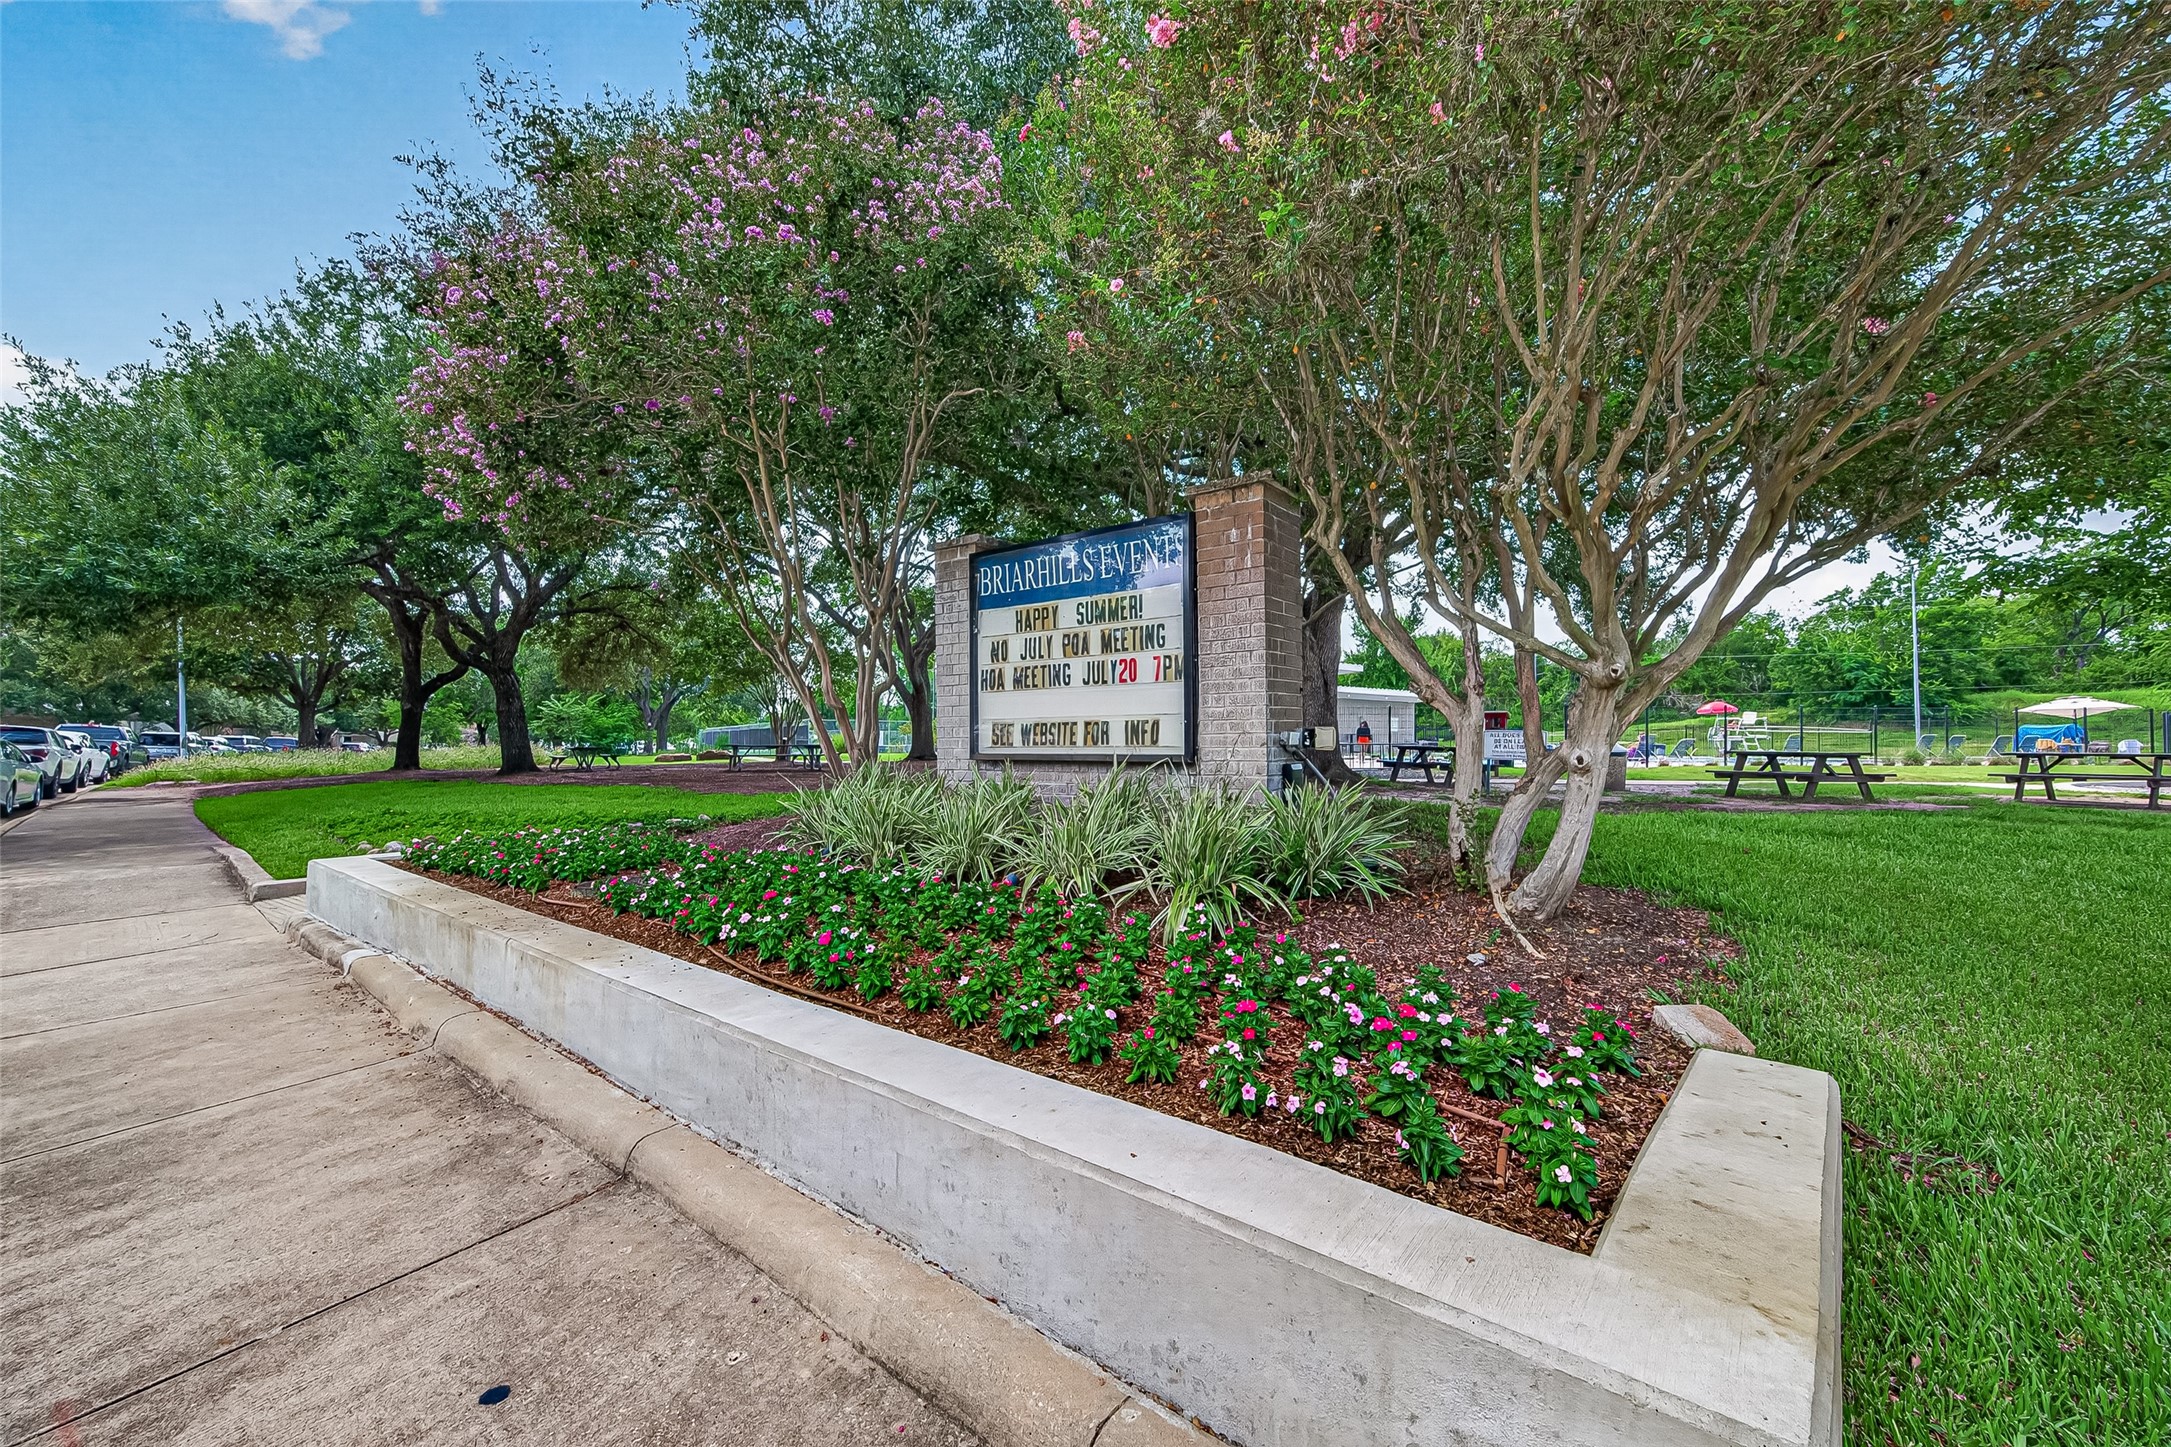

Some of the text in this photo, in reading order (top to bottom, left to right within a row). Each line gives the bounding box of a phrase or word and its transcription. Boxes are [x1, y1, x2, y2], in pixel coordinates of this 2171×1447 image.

[979, 549, 1095, 597] BRIARHILLS
[1015, 594, 1143, 634] HAPPY SUMMER!
[990, 623, 1166, 663] NO JULY POA MEETING
[980, 667, 1005, 692] HOA
[1012, 662, 1071, 690] MEETING
[991, 719, 1160, 746] SEE WEBSITE FOR INFO
